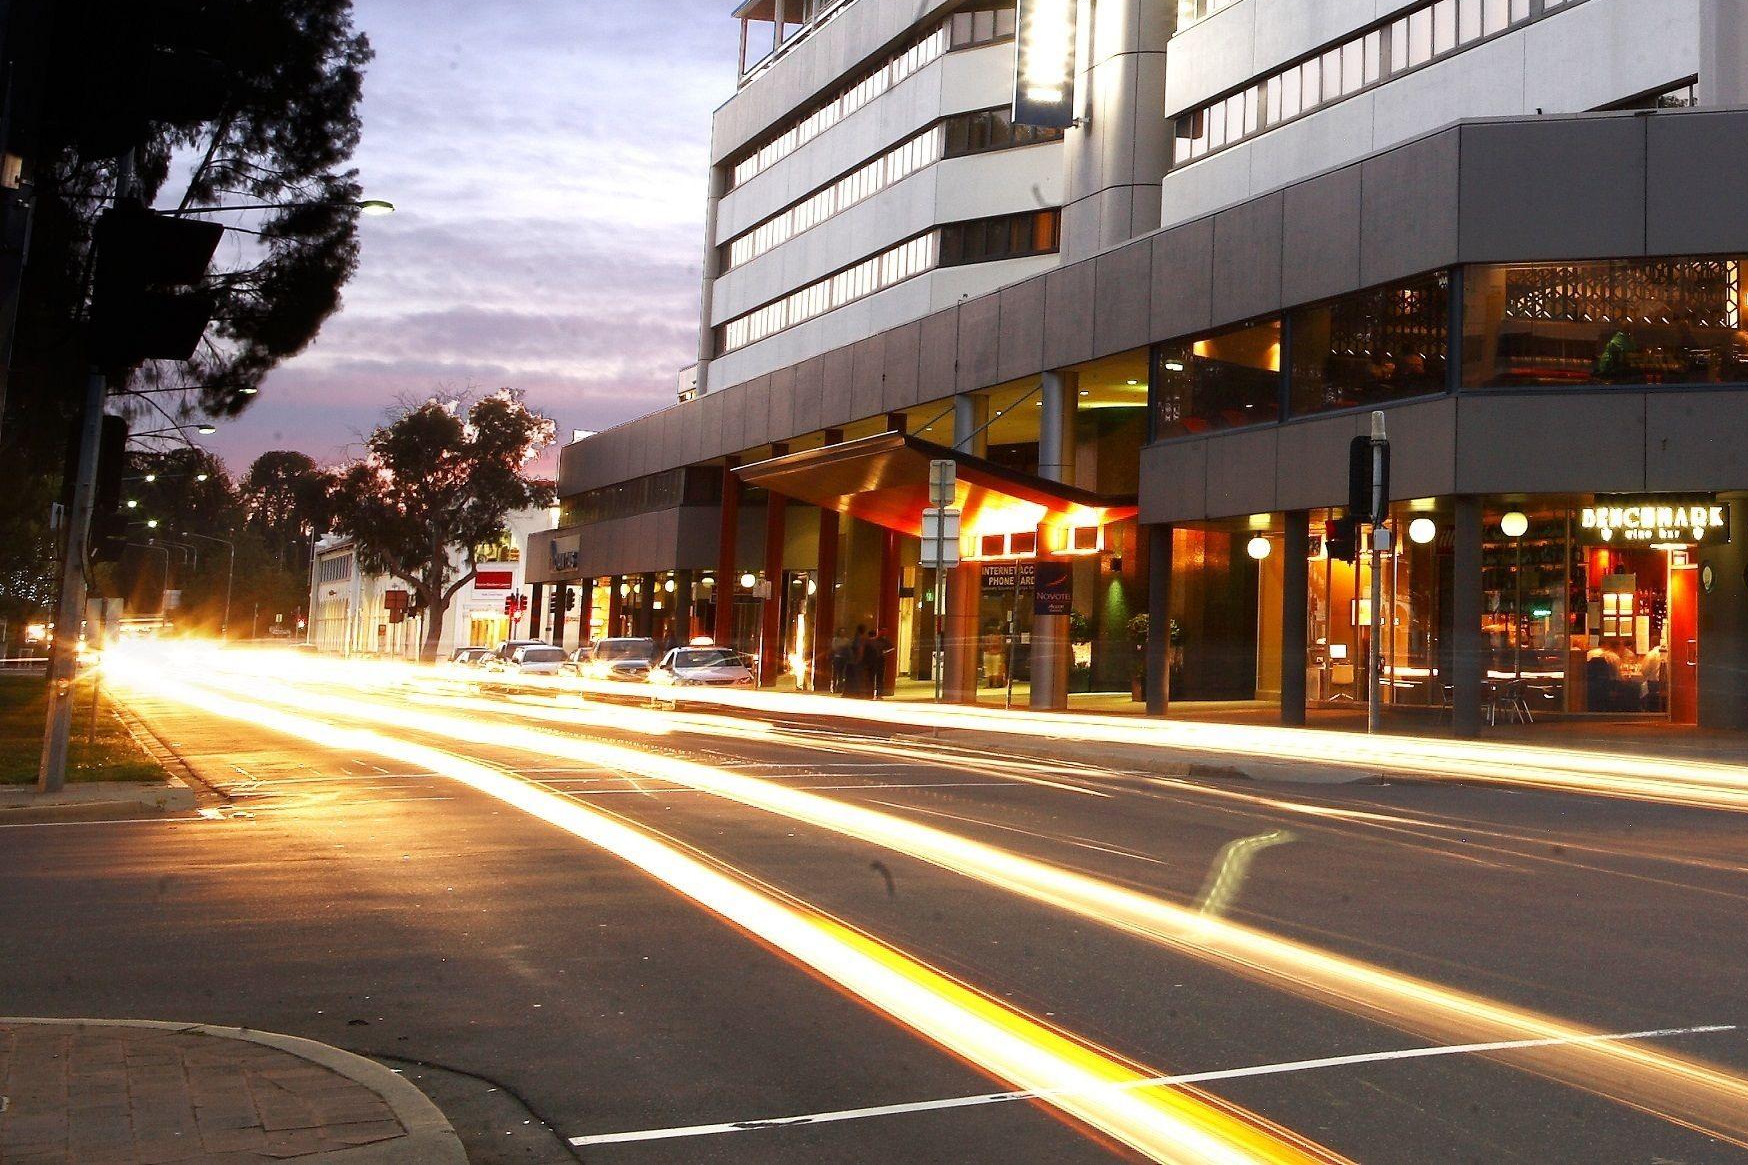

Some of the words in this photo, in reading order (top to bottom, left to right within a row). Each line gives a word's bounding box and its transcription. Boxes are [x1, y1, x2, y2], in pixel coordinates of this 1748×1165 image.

[1581, 506, 1725, 528] BENCHMARK
[982, 566, 1017, 575] INTERNET
[988, 576, 1014, 586] PHONE
